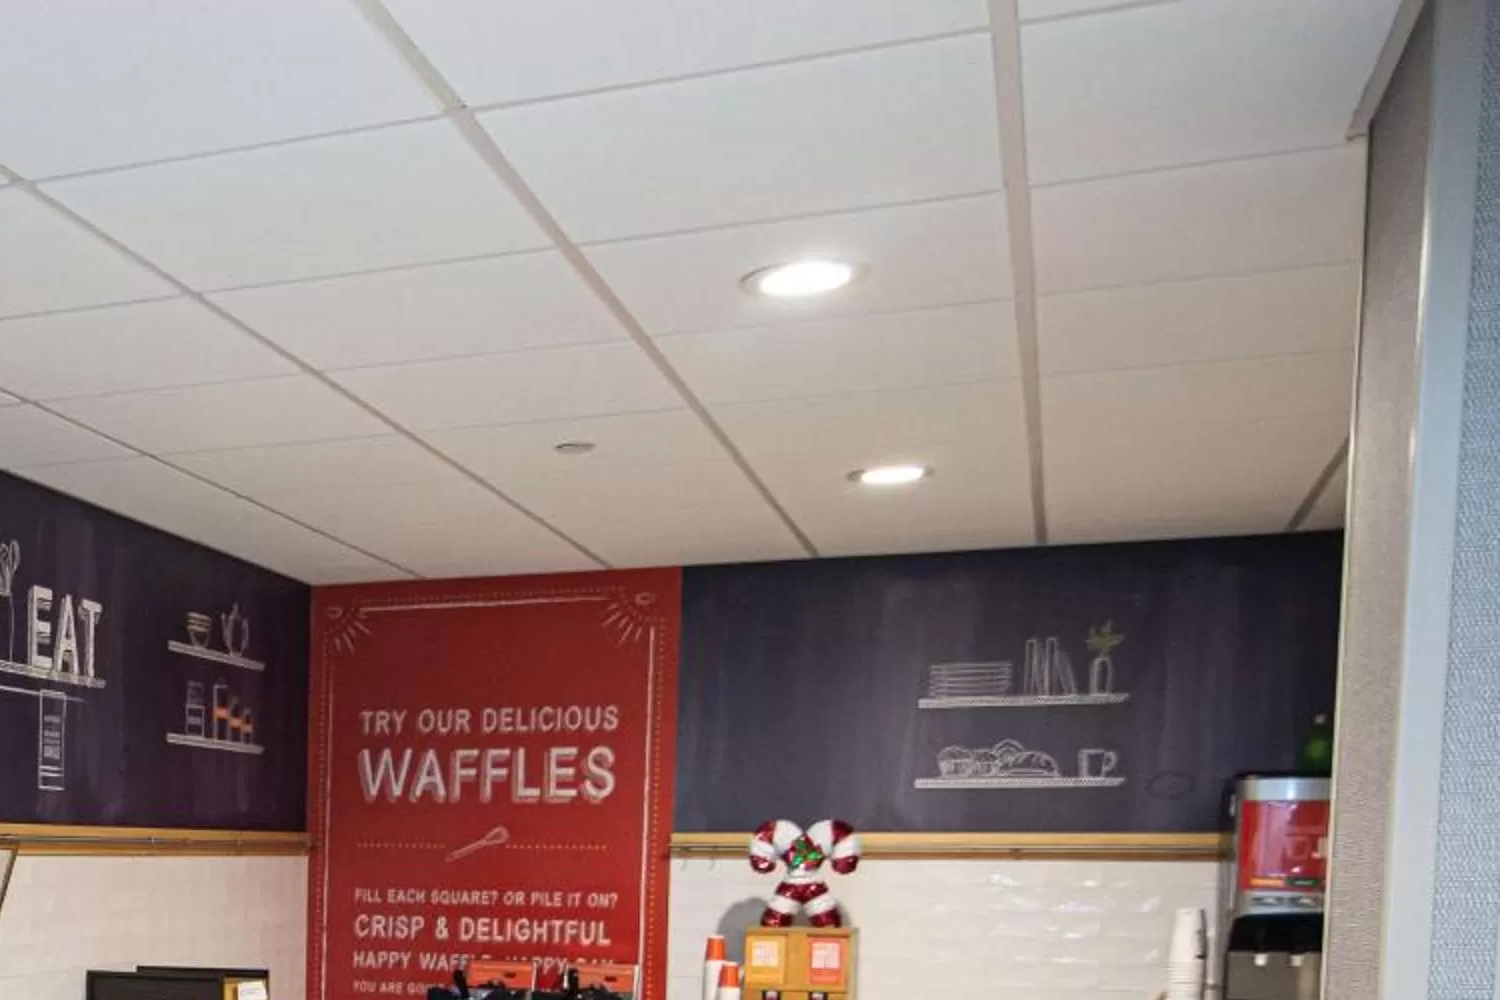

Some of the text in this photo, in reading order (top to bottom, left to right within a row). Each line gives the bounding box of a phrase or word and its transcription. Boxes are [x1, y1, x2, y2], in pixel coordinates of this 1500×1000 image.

[28, 584, 103, 679] EAT
[359, 705, 619, 735] TRY OUR DELICIOUS
[357, 745, 616, 804] WAFFLES
[354, 888, 619, 909] FILL EACH SQUARE? OR PILE IT ON?
[354, 913, 612, 946] CRISP & DELIGHTFUL
[353, 950, 412, 969] HAPPY
[419, 952, 493, 972] WAFF
[352, 980, 377, 993] YOU
[380, 982, 403, 995] ARE
